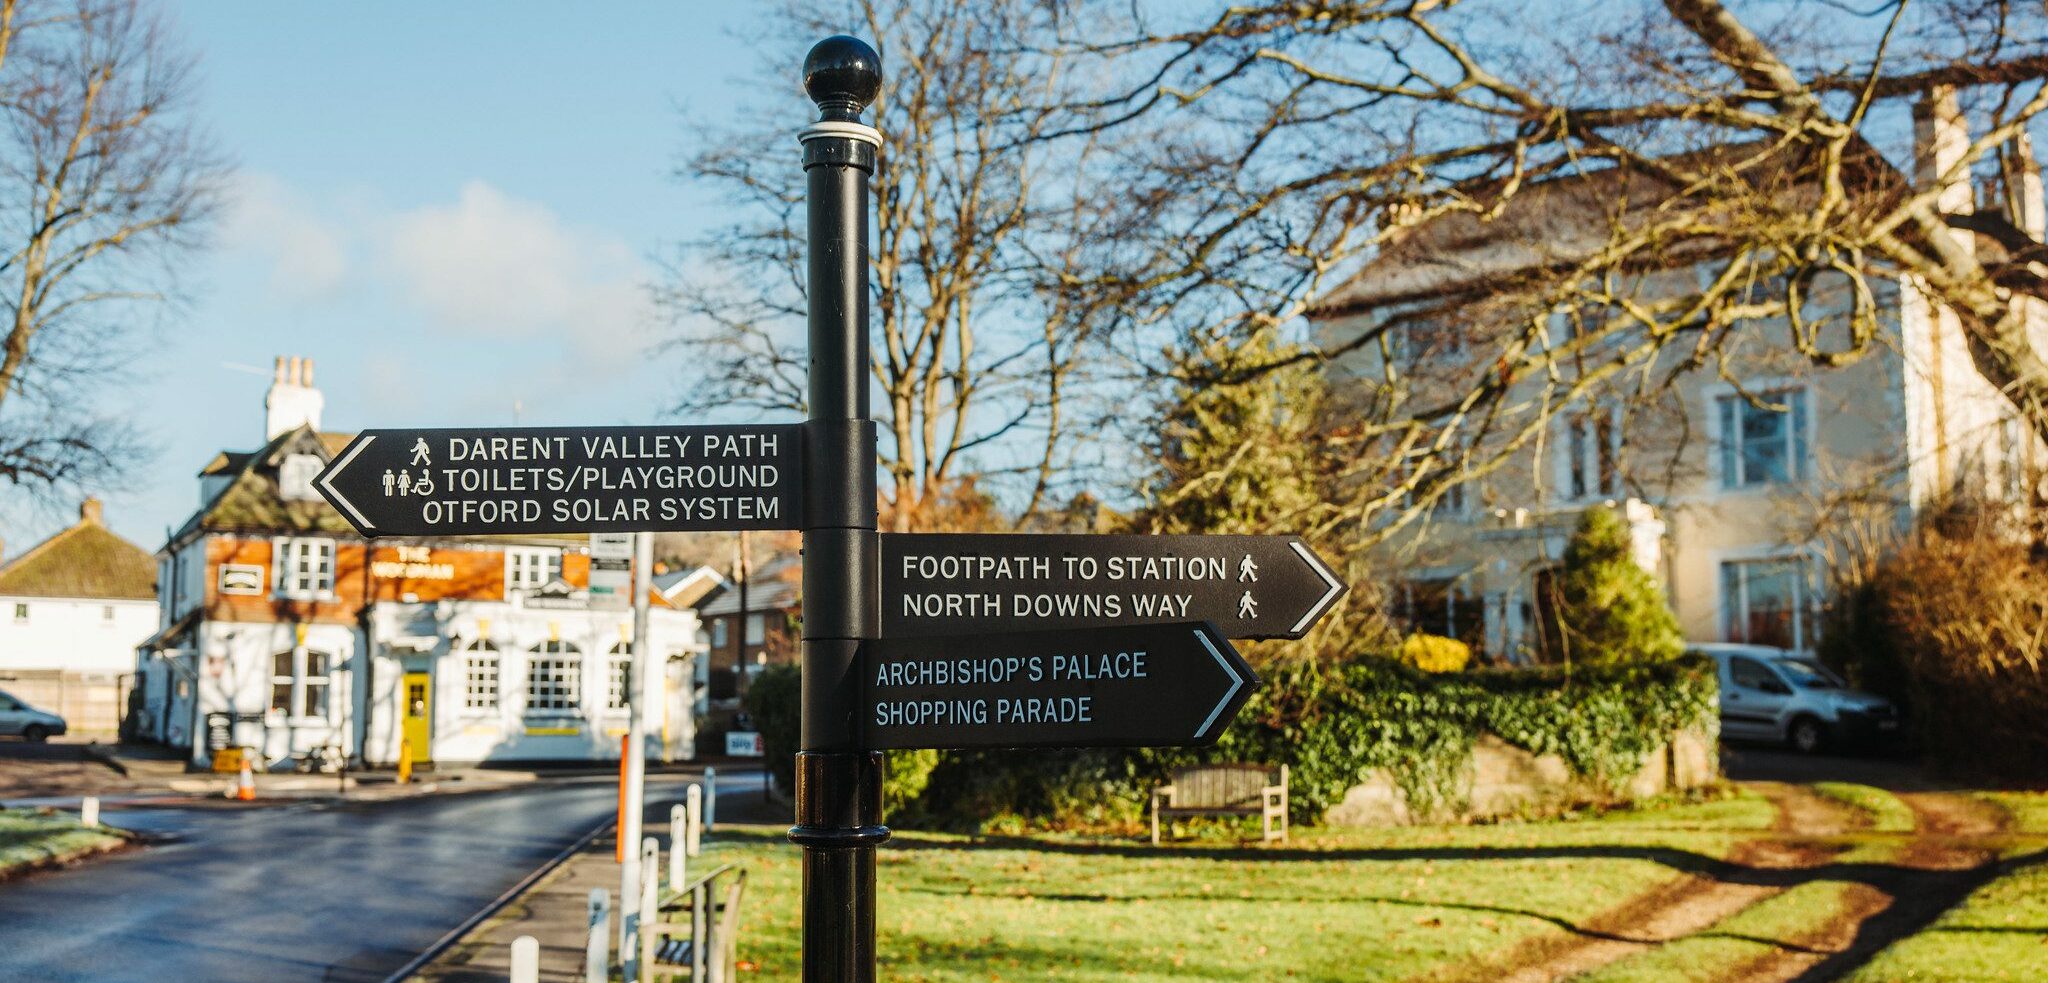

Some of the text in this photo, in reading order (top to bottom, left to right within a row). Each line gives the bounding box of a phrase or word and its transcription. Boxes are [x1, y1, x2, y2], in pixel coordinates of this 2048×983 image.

[449, 434, 778, 461] DARENT VALLEY PATH
[442, 465, 778, 493] TOILETS/PLAYGROUND
[422, 496, 779, 525] OTFORD SOLAR SYSTEM
[903, 556, 1227, 580] FOOTPATH TO STATION
[903, 594, 1193, 617] NORTH DOWNS WAY
[876, 651, 1147, 686] ARCHBISHOP'S PALACE
[875, 696, 1092, 726] SHOPPING PARADE
